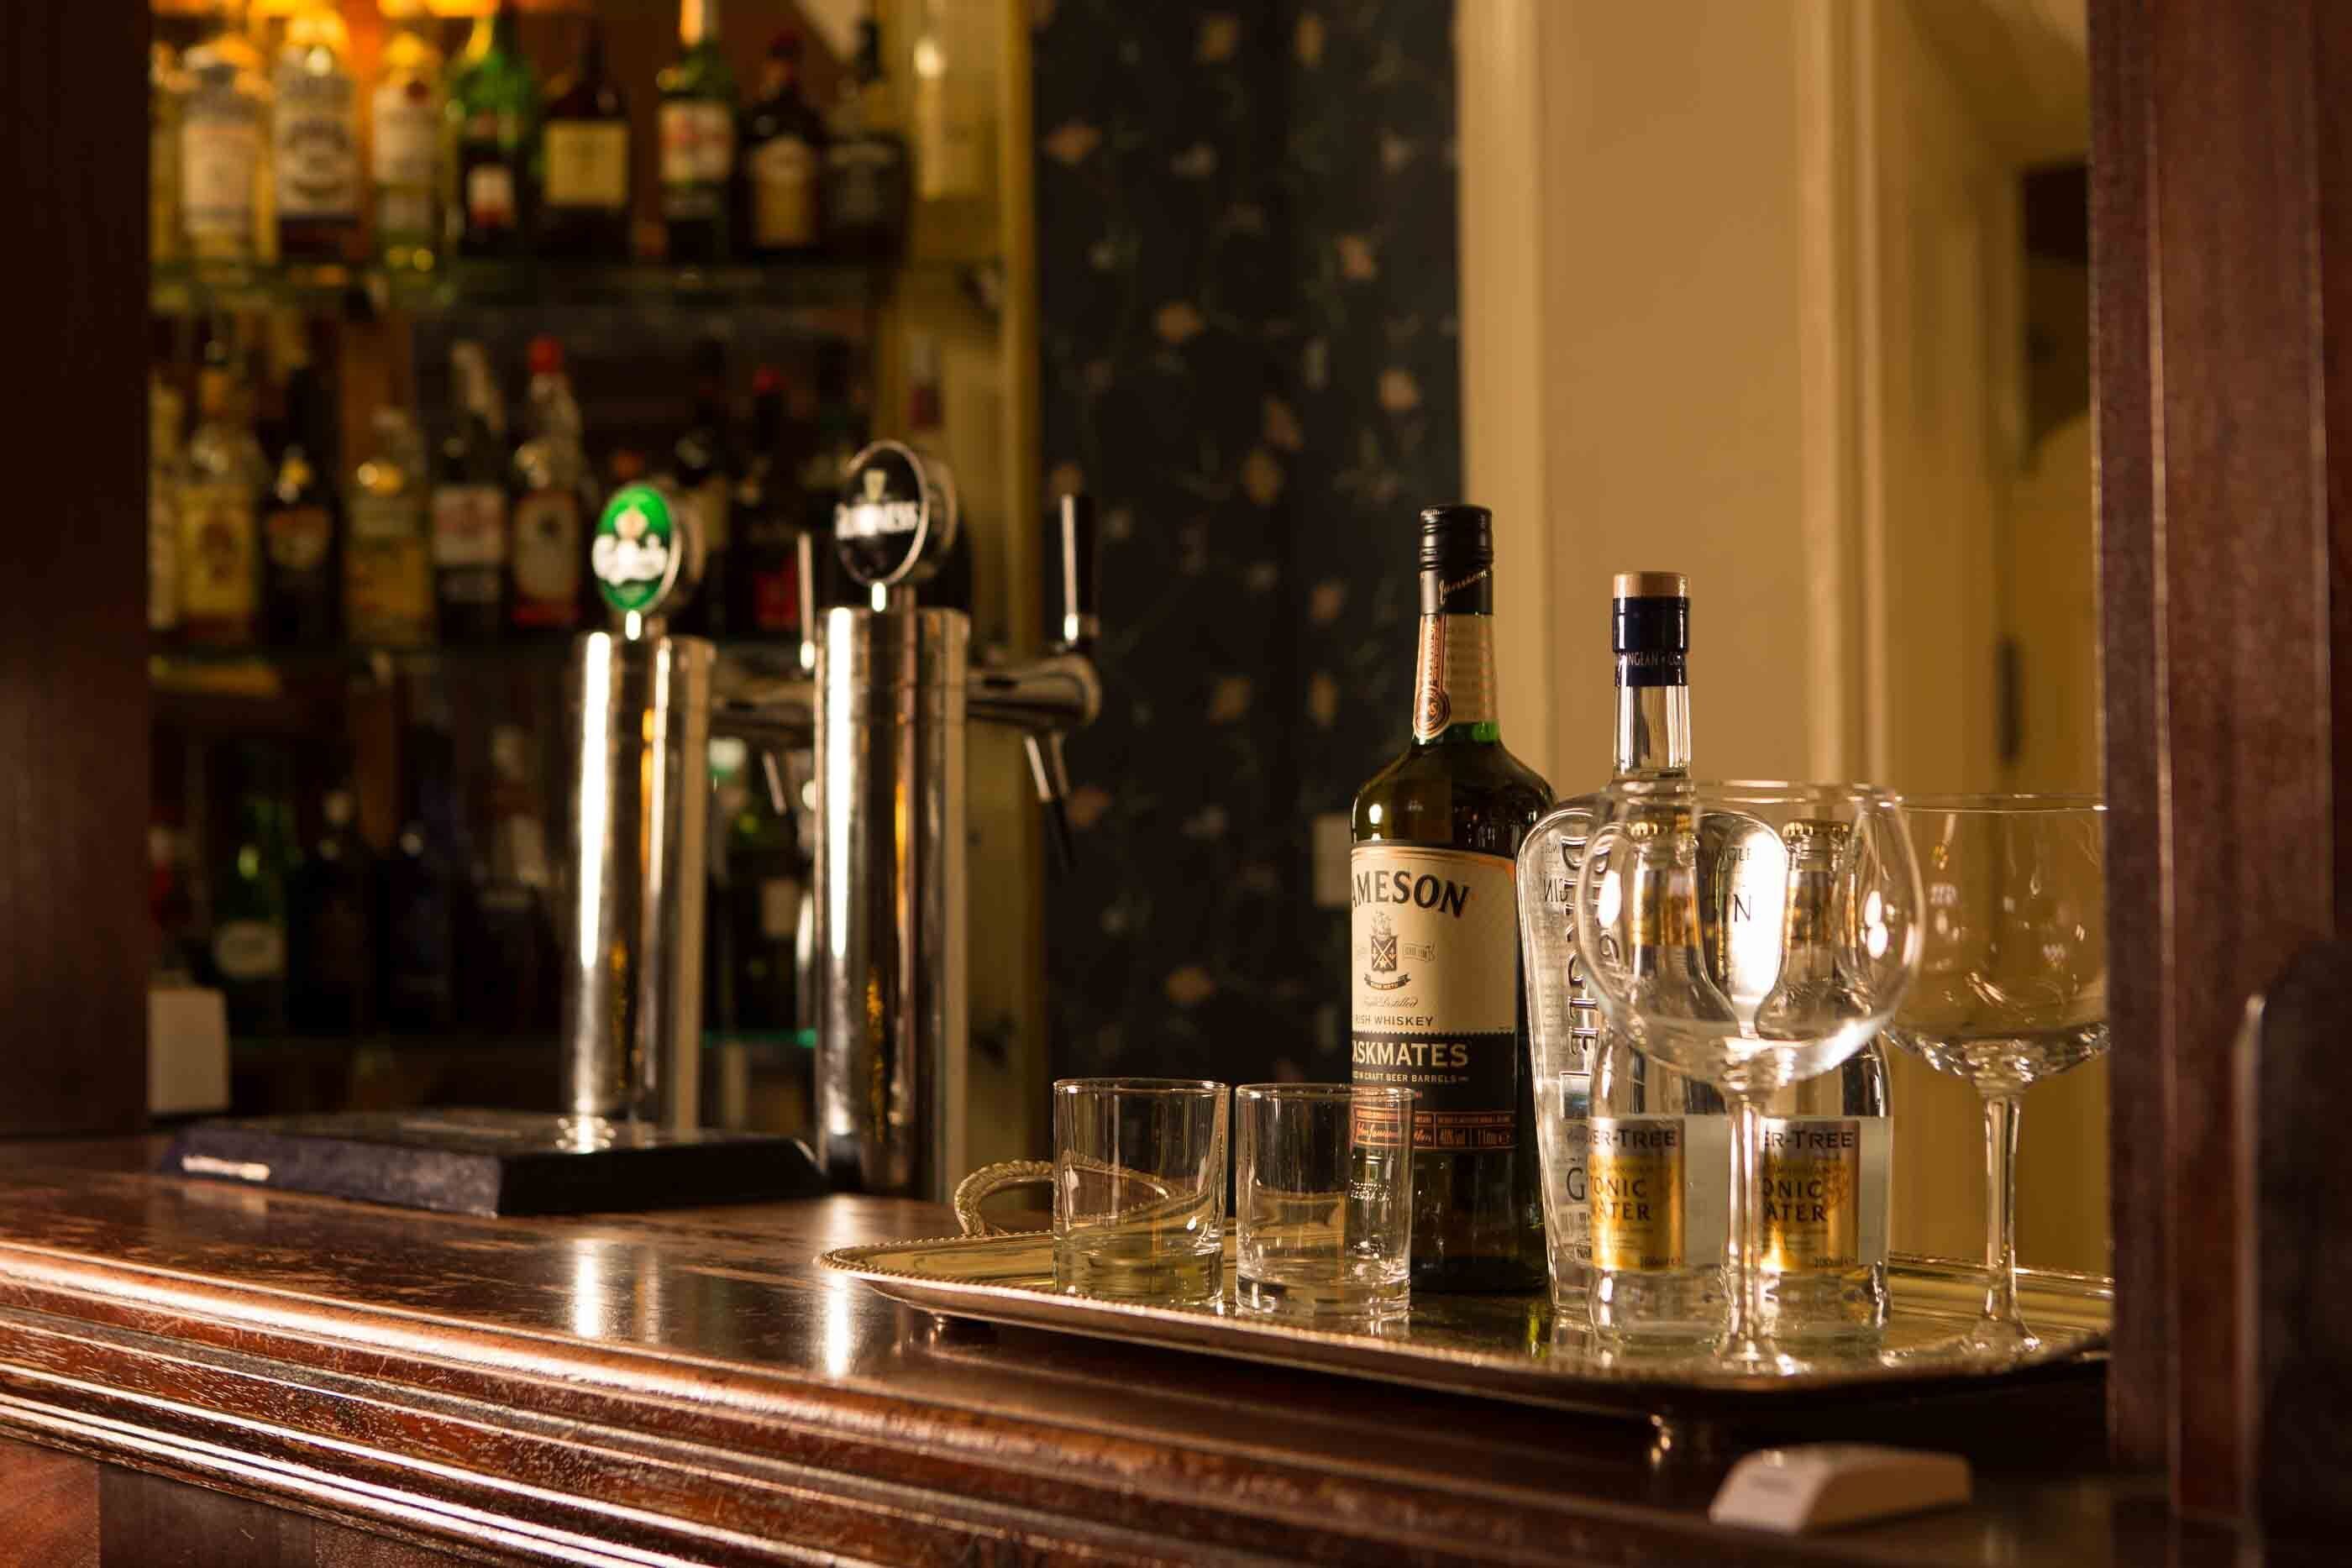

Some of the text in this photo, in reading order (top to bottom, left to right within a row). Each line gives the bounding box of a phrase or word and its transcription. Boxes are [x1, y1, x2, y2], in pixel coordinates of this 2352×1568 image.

[1373, 1015, 1434, 1027] WHISKEY
[1386, 1073, 1409, 1083] BEER
[1410, 1074, 1457, 1083] BARRELS
